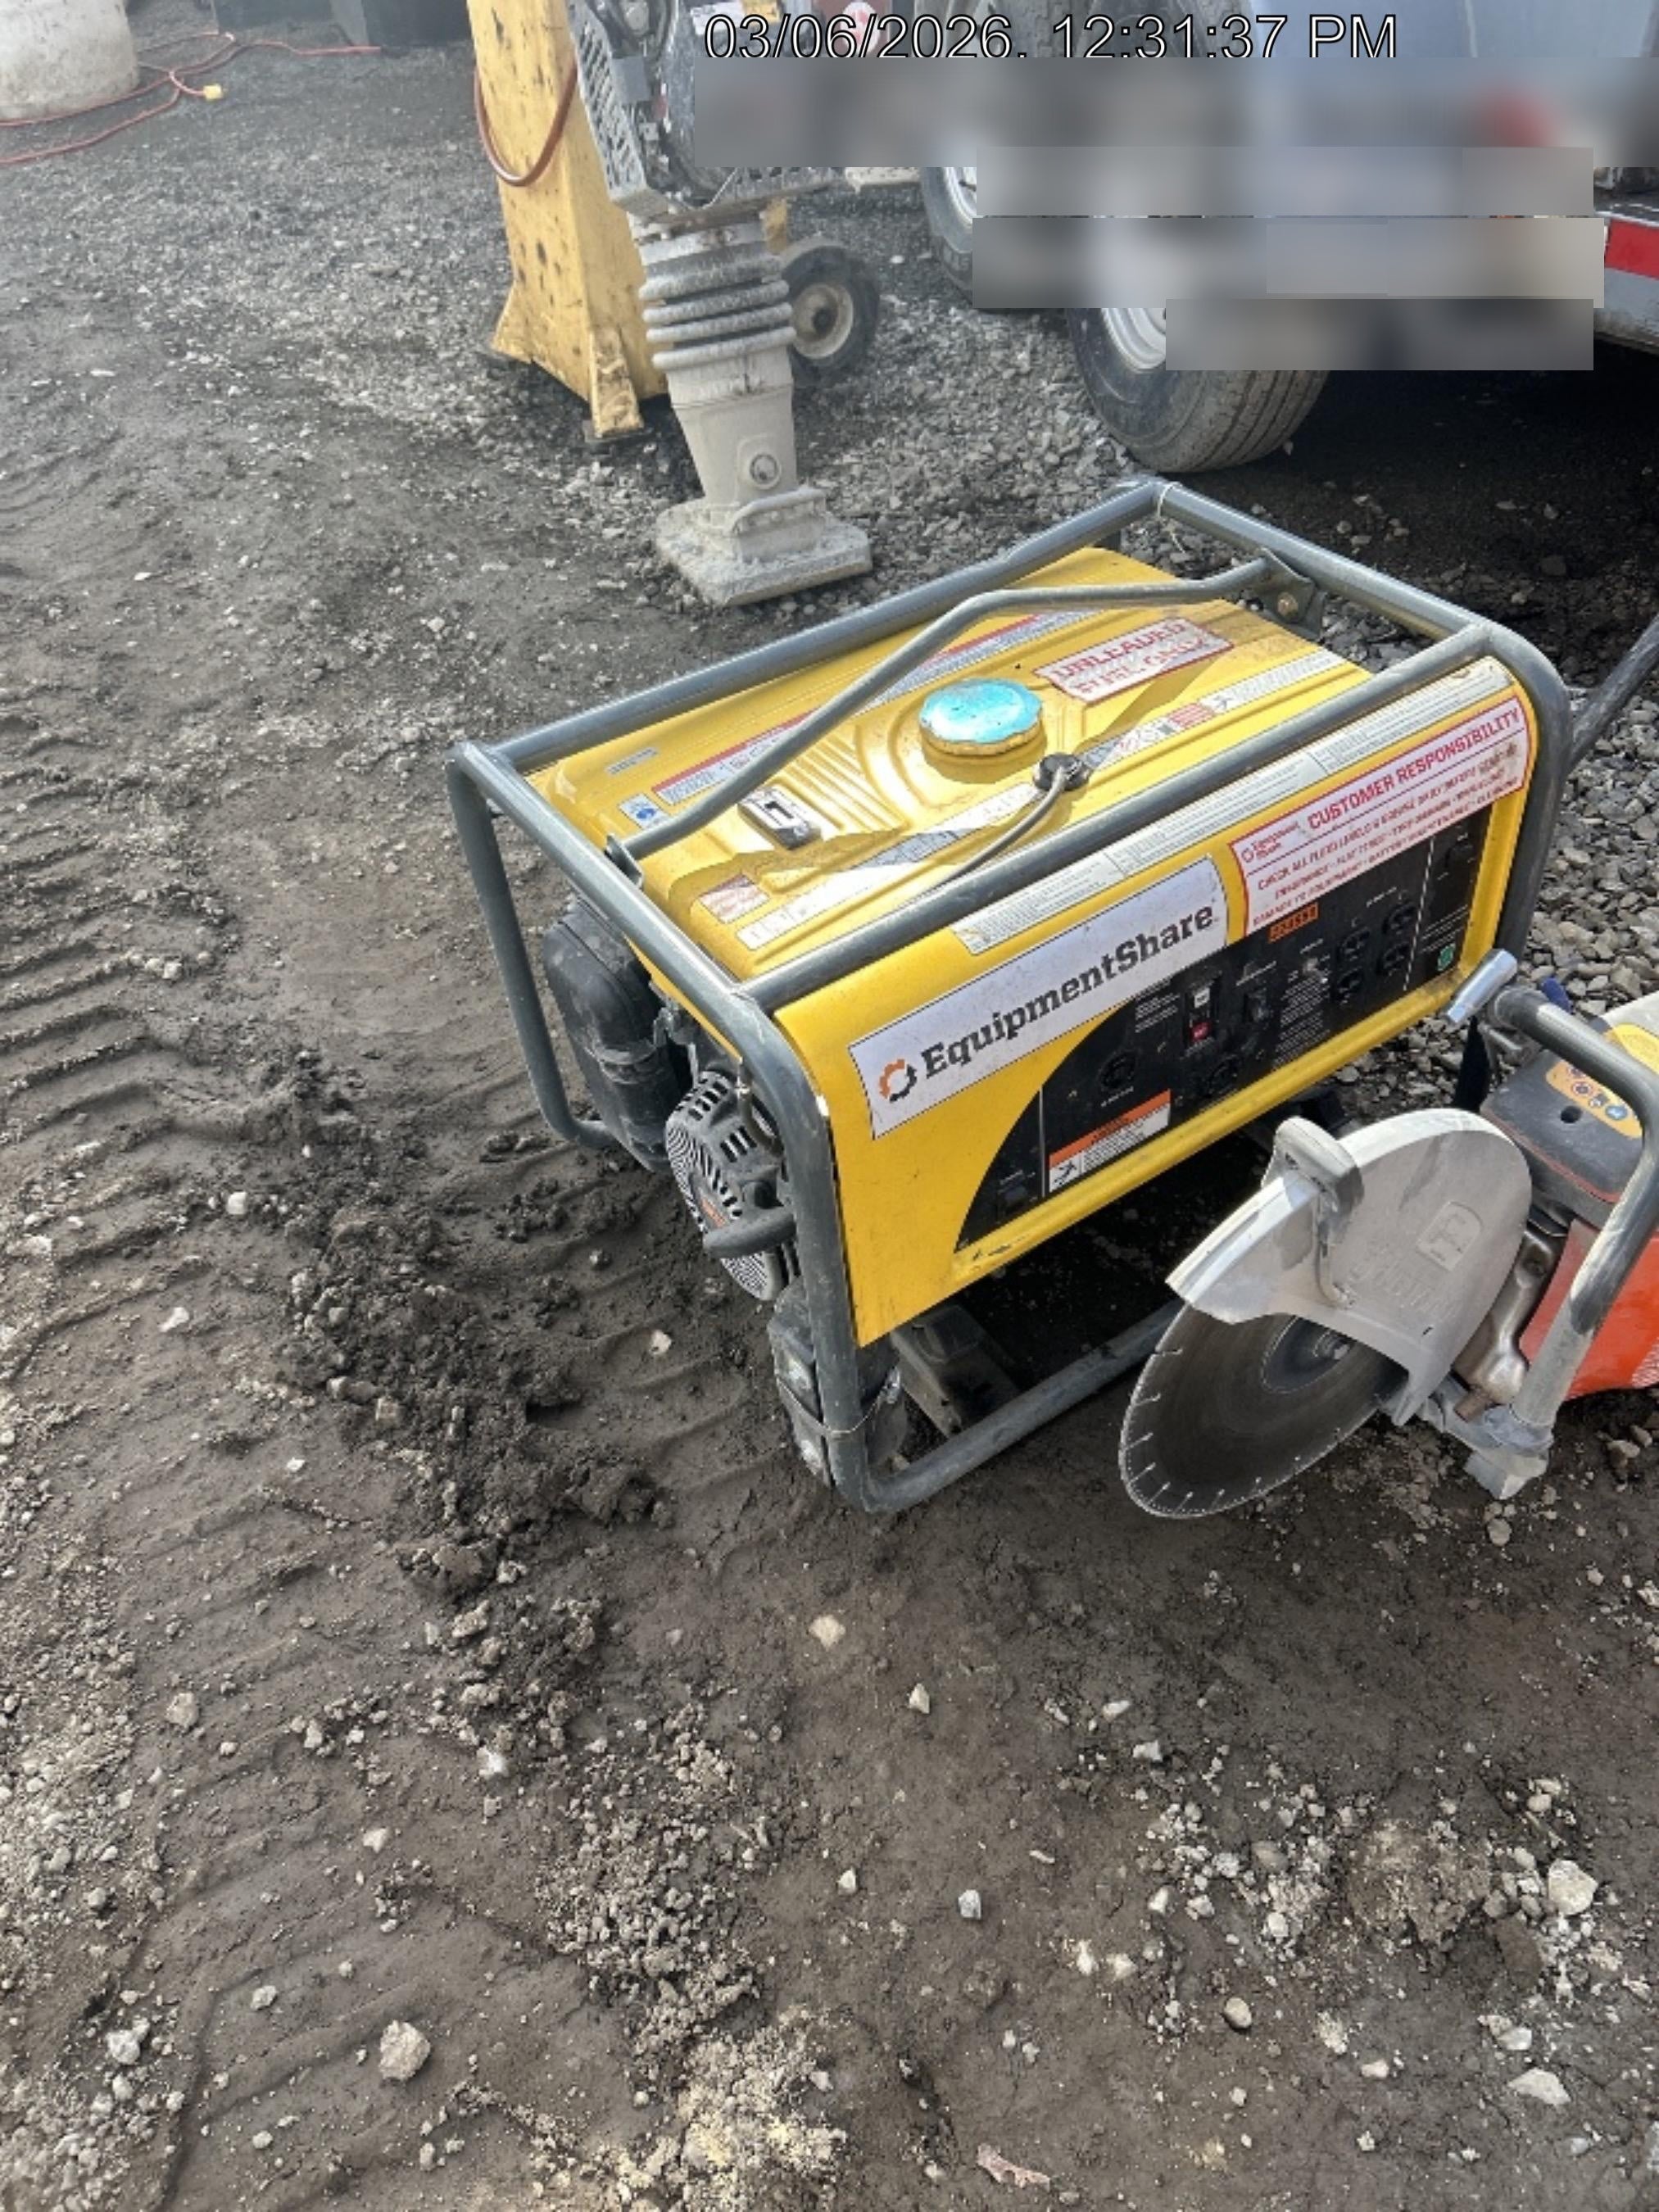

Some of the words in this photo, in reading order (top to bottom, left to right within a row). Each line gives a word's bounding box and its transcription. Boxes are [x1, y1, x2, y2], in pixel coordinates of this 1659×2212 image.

[1054, 623, 1185, 675] UNLEADED
[1308, 775, 1394, 829] CUSTOMER
[1396, 708, 1521, 783] RESPONSIBILITY
[919, 904, 1213, 1080] EquipmentShare
